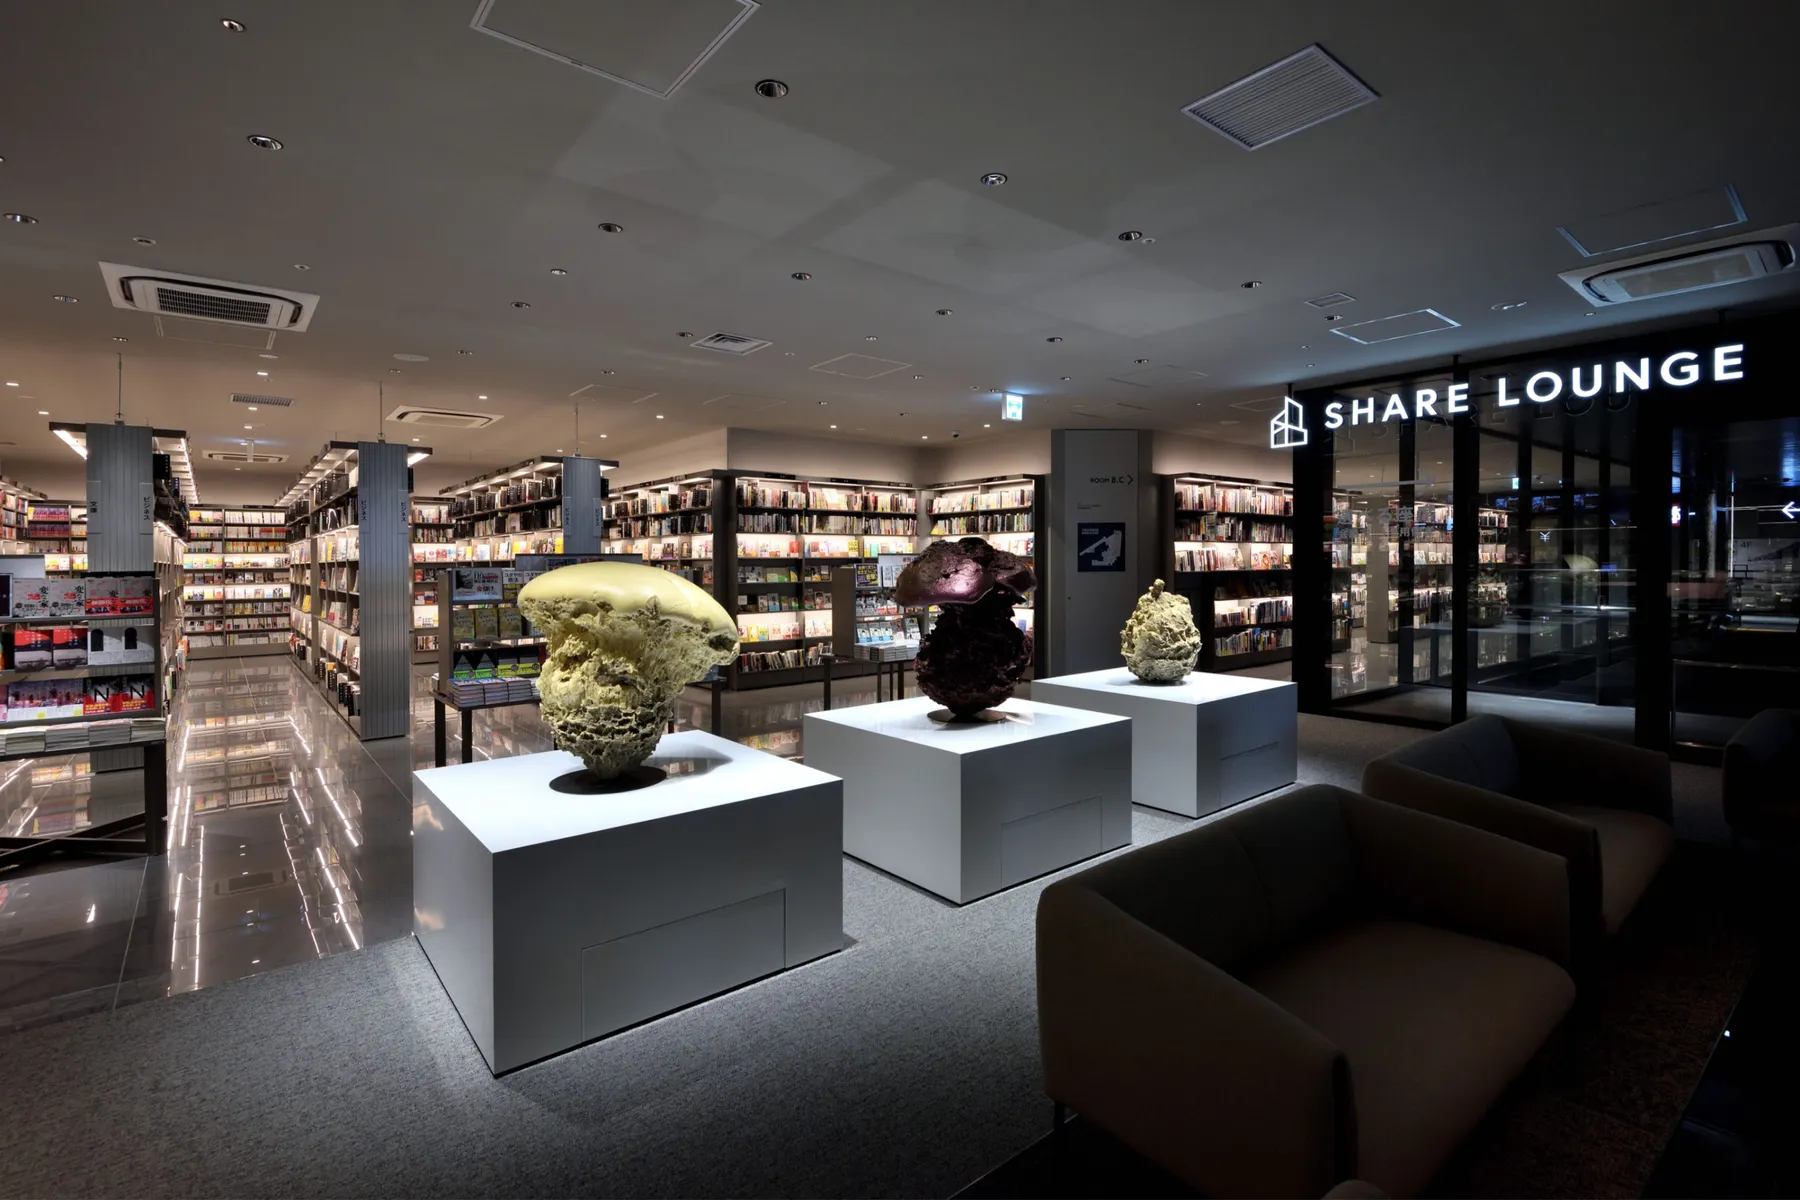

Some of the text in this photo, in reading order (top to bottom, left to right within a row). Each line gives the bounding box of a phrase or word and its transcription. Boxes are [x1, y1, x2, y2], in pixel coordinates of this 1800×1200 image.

[1324, 343, 1745, 430] SHARE LOUNGE
[94, 687, 109, 702] N
[130, 685, 145, 699] N
